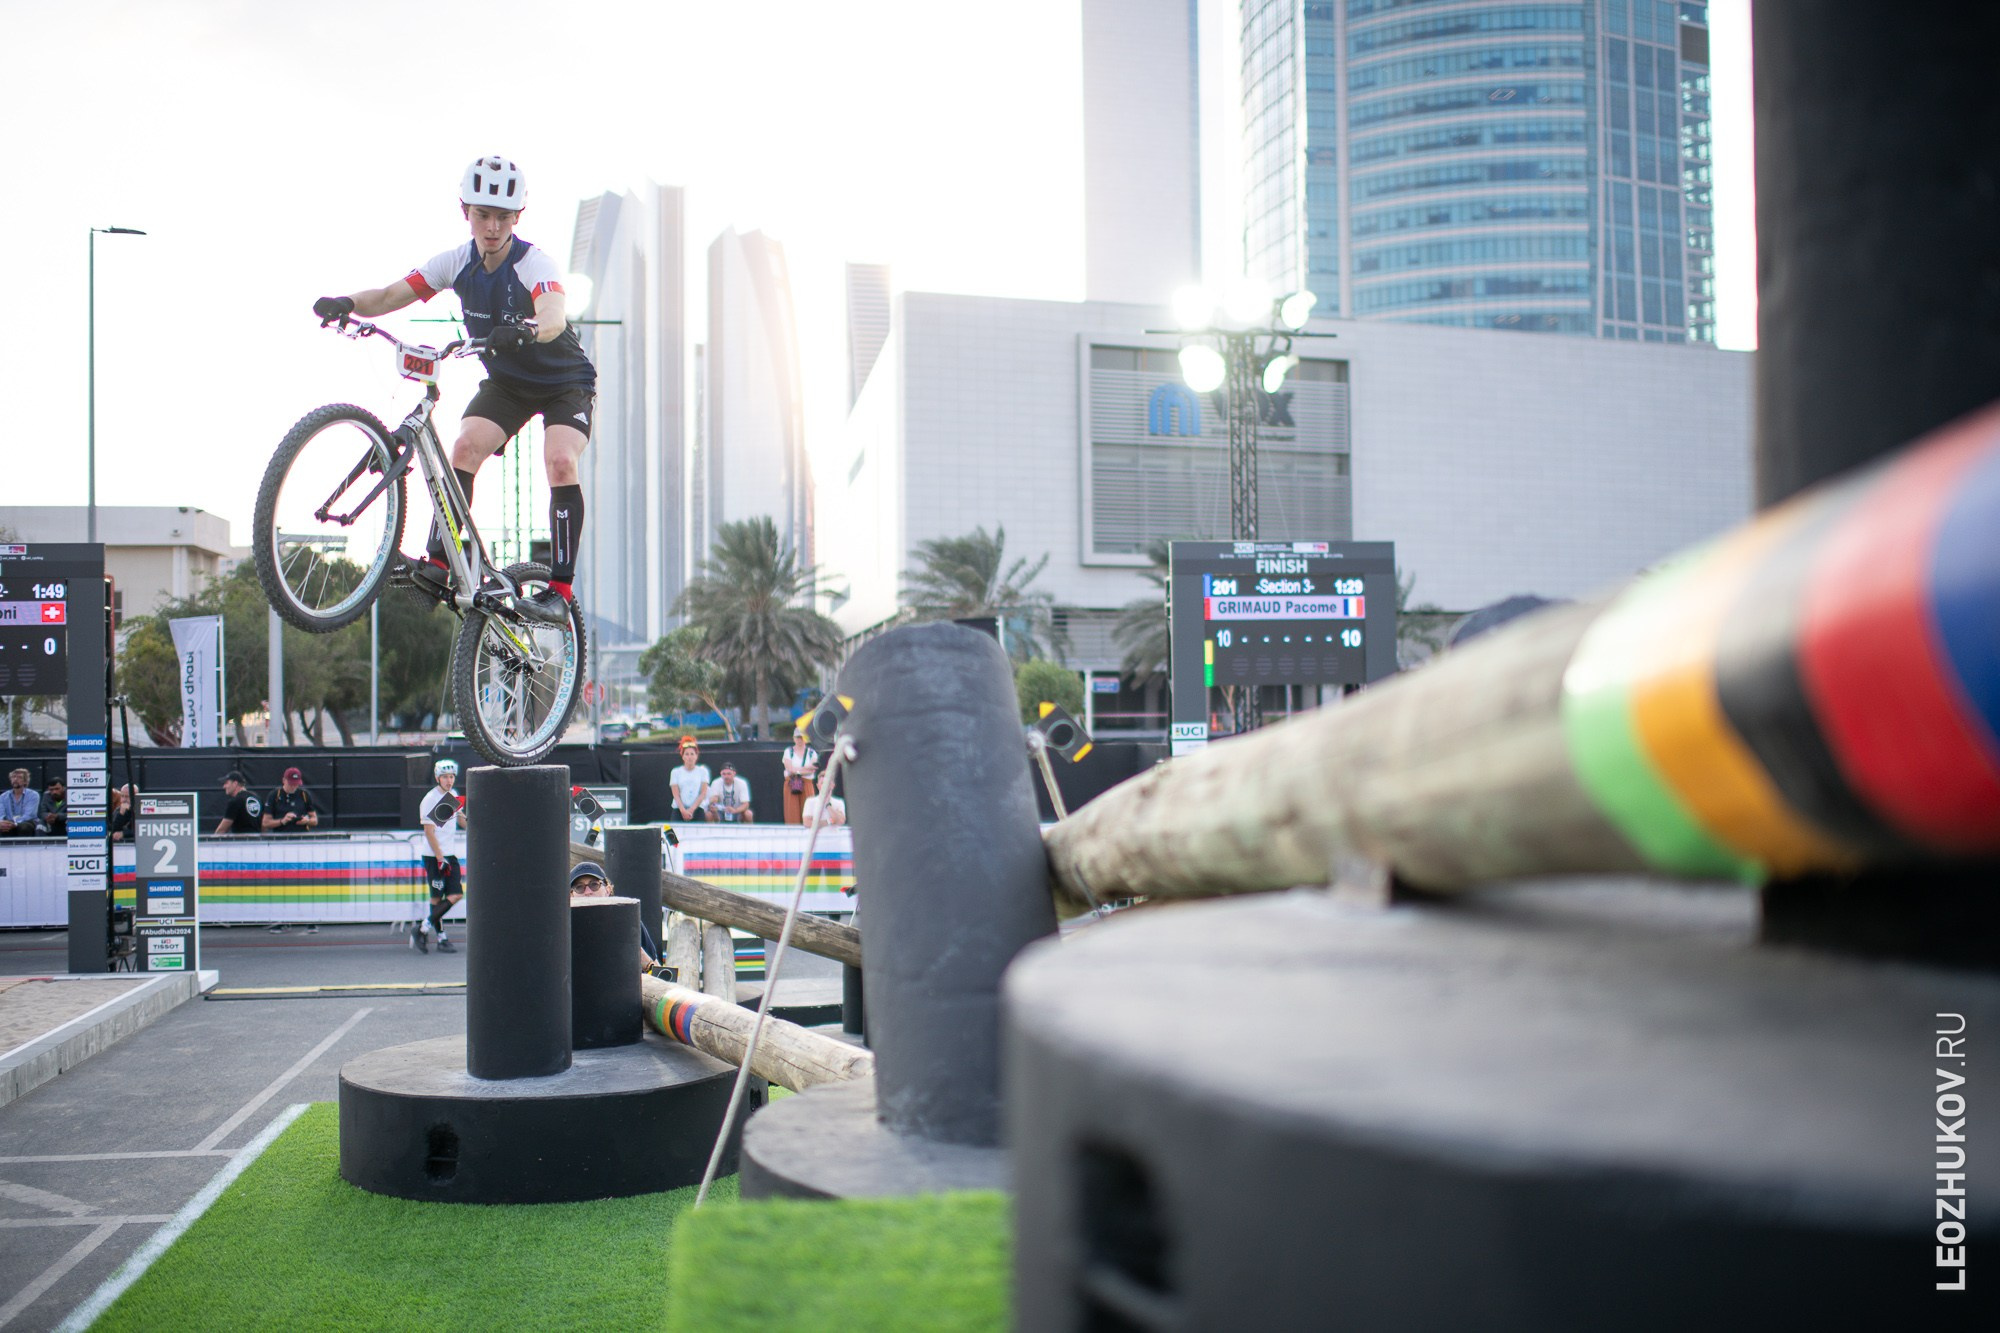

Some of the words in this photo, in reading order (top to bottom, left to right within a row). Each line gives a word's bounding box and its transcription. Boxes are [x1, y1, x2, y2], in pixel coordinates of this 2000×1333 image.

[406, 356, 430, 374] 201
[1256, 560, 1308, 574] FINISH
[32, 584, 64, 598] 1:49
[1212, 580, 1237, 595] 201
[1218, 601, 1281, 613] GRIMAUD
[1286, 601, 1337, 613] Pacome
[1216, 630, 1232, 647] 10
[1341, 630, 1362, 647] 10
[44, 638, 56, 655] 0
[185, 652, 194, 694] dhabi
[188, 700, 196, 727] abu
[1181, 727, 1203, 736] UCI
[138, 823, 191, 837] FINISH
[153, 838, 178, 873] 2
[75, 860, 100, 870] UCI
